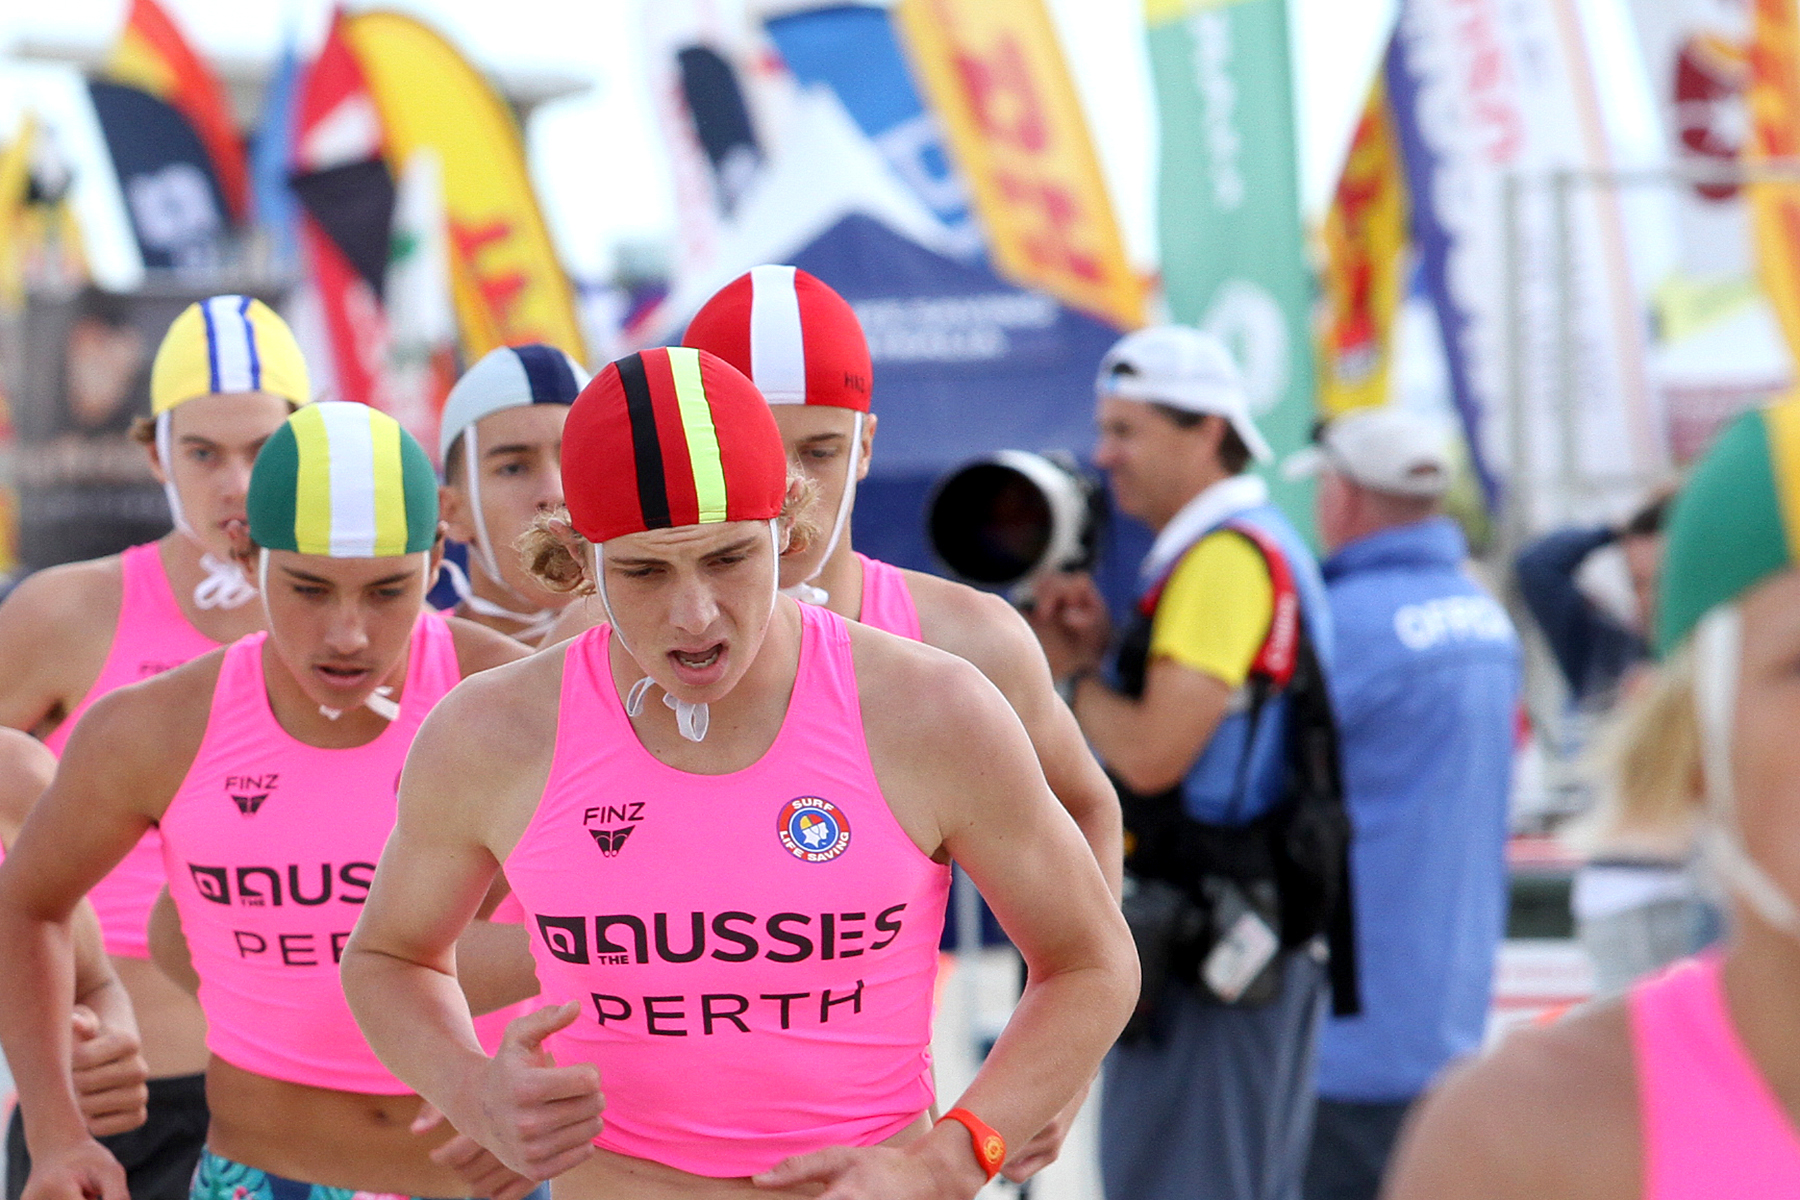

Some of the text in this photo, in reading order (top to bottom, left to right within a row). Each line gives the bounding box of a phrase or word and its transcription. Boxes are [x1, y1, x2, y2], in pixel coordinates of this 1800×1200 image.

[225, 774, 279, 791] FINZ
[583, 802, 646, 825] FINZ
[792, 798, 834, 811] SURF
[779, 830, 849, 861] LIFE SAVING
[595, 903, 908, 965] THE AUSSIES
[591, 979, 865, 1037] PERTH
